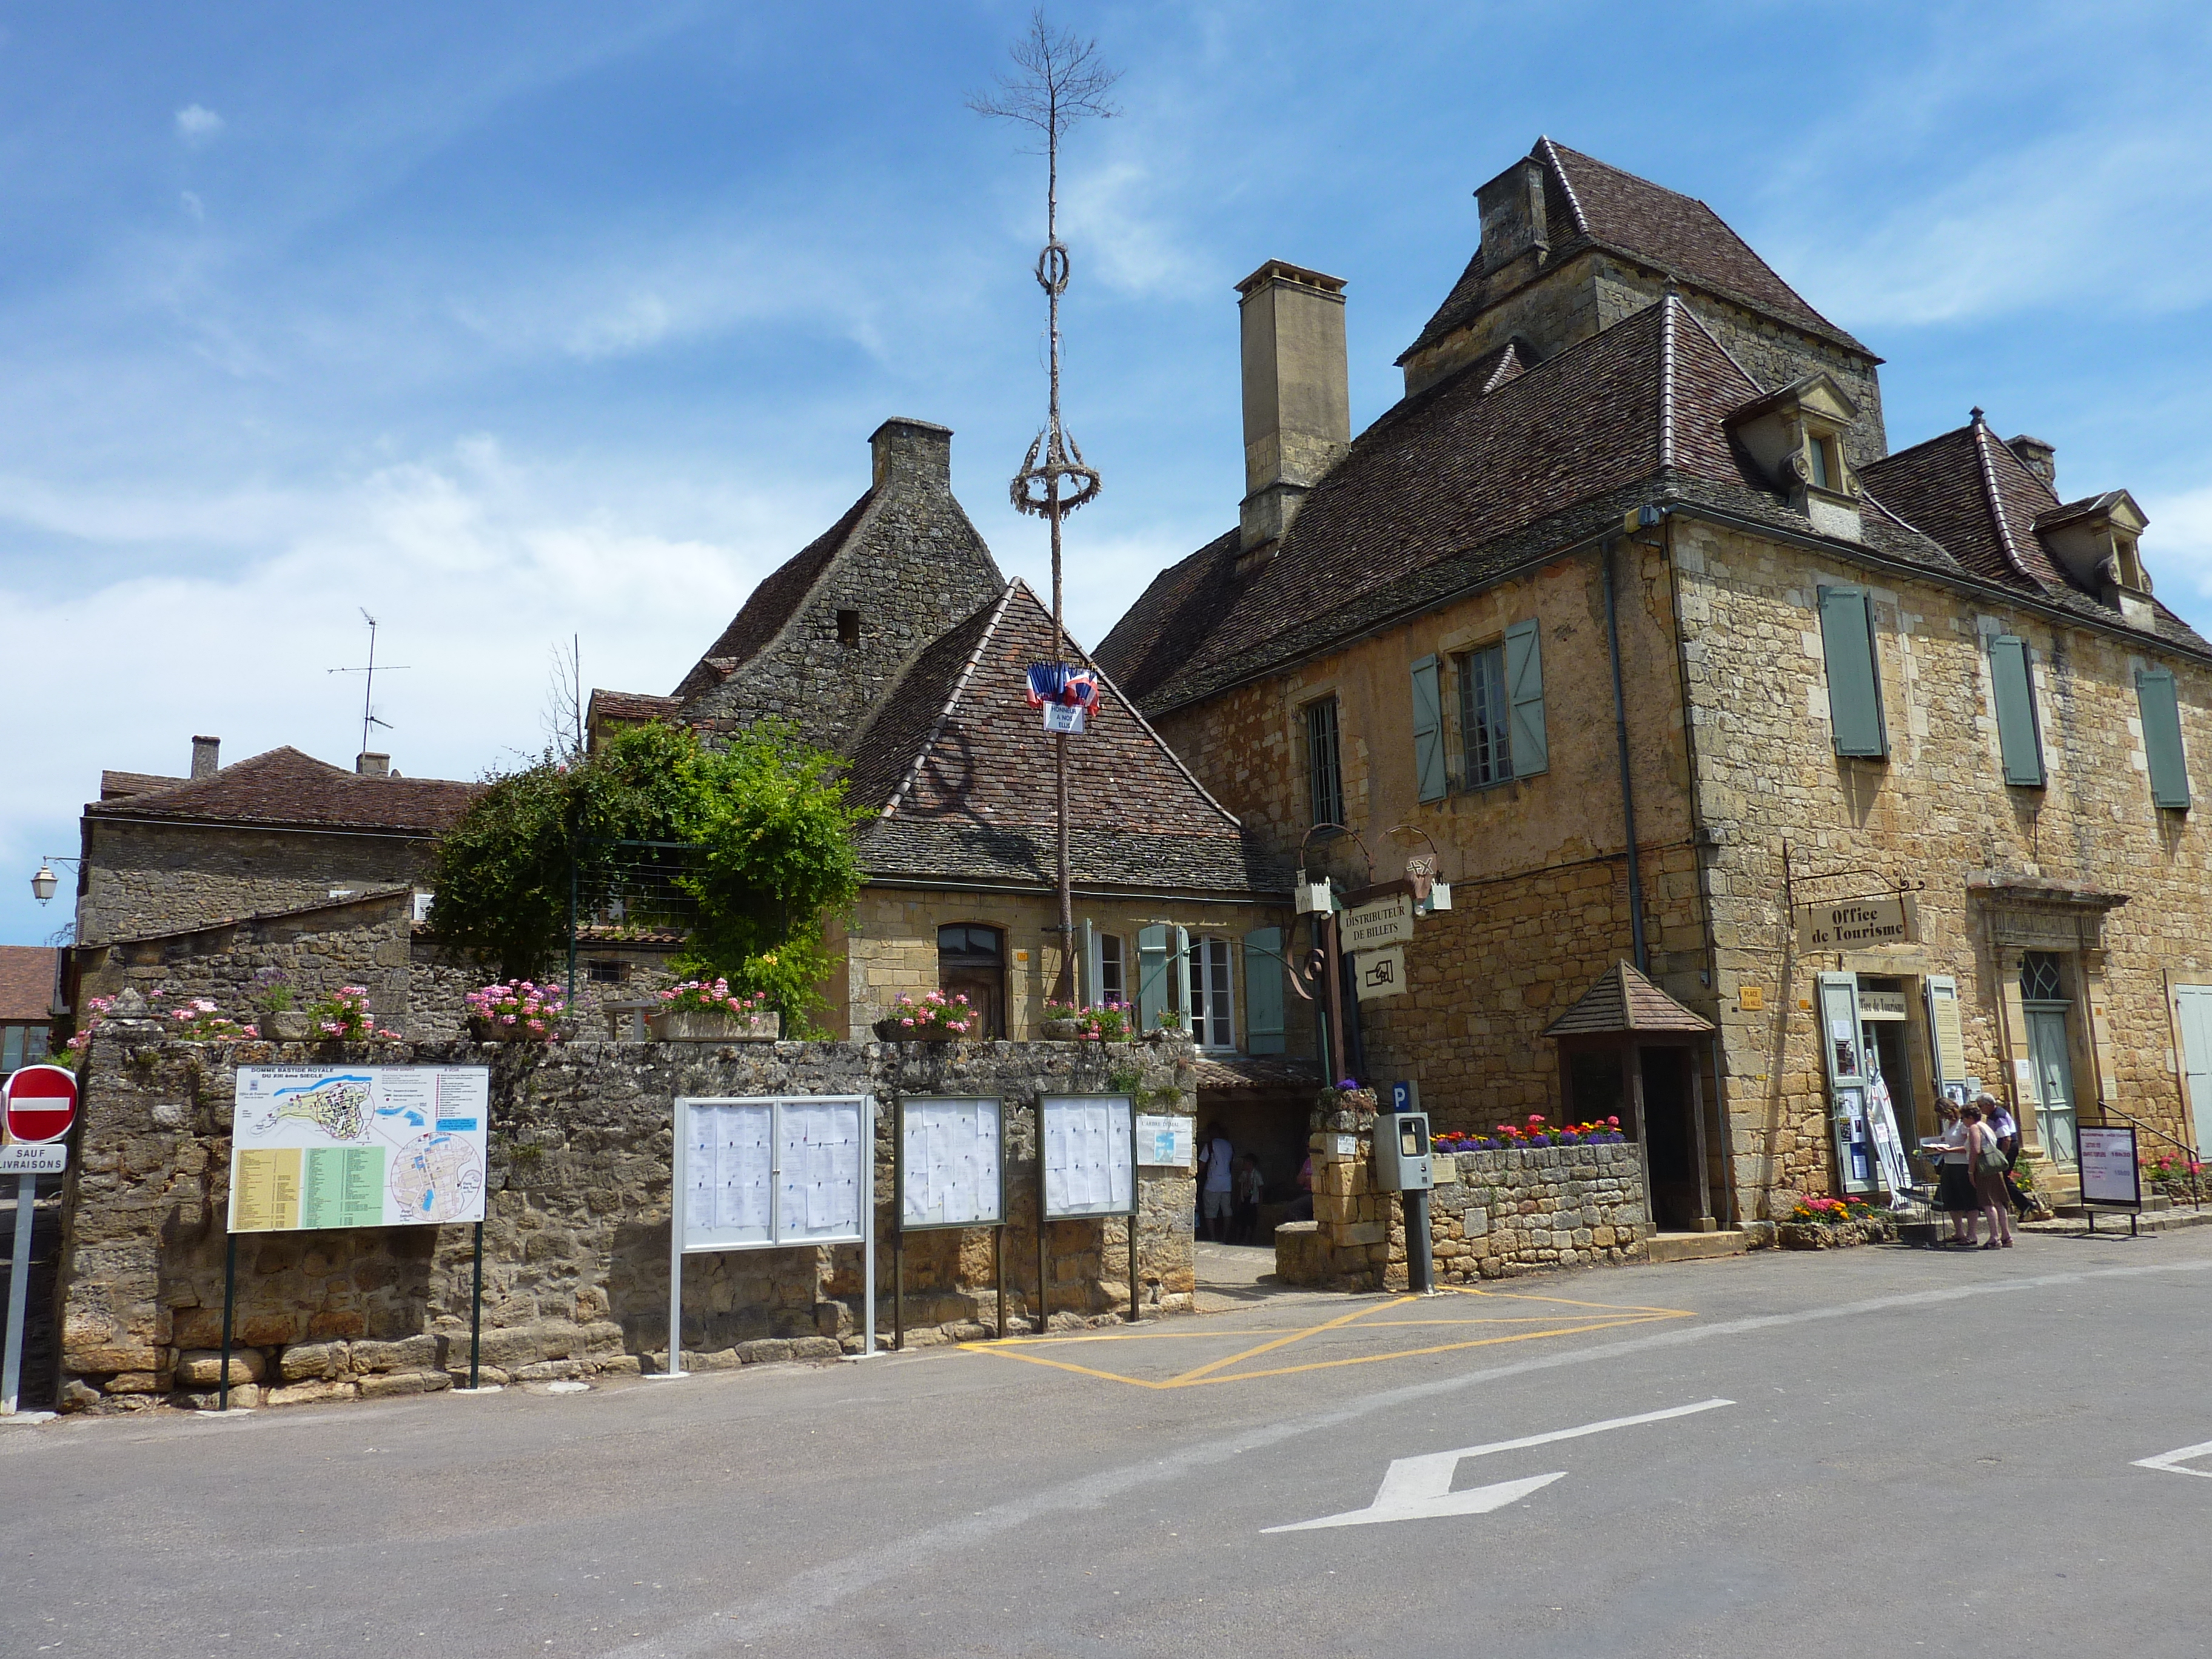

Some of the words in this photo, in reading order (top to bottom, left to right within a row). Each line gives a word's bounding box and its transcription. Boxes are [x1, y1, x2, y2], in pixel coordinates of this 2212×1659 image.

[1051, 705, 1076, 714] HONNEUR
[1346, 906, 1405, 927] DISTRIBUTEUR
[1832, 907, 1878, 925] Office
[1353, 930, 1364, 940] DE
[1367, 922, 1398, 938] BILLETS
[1812, 929, 1829, 943] de
[1834, 922, 1903, 941] Tourisme
[1873, 998, 1879, 1012] de
[1395, 1088, 1406, 1107] P
